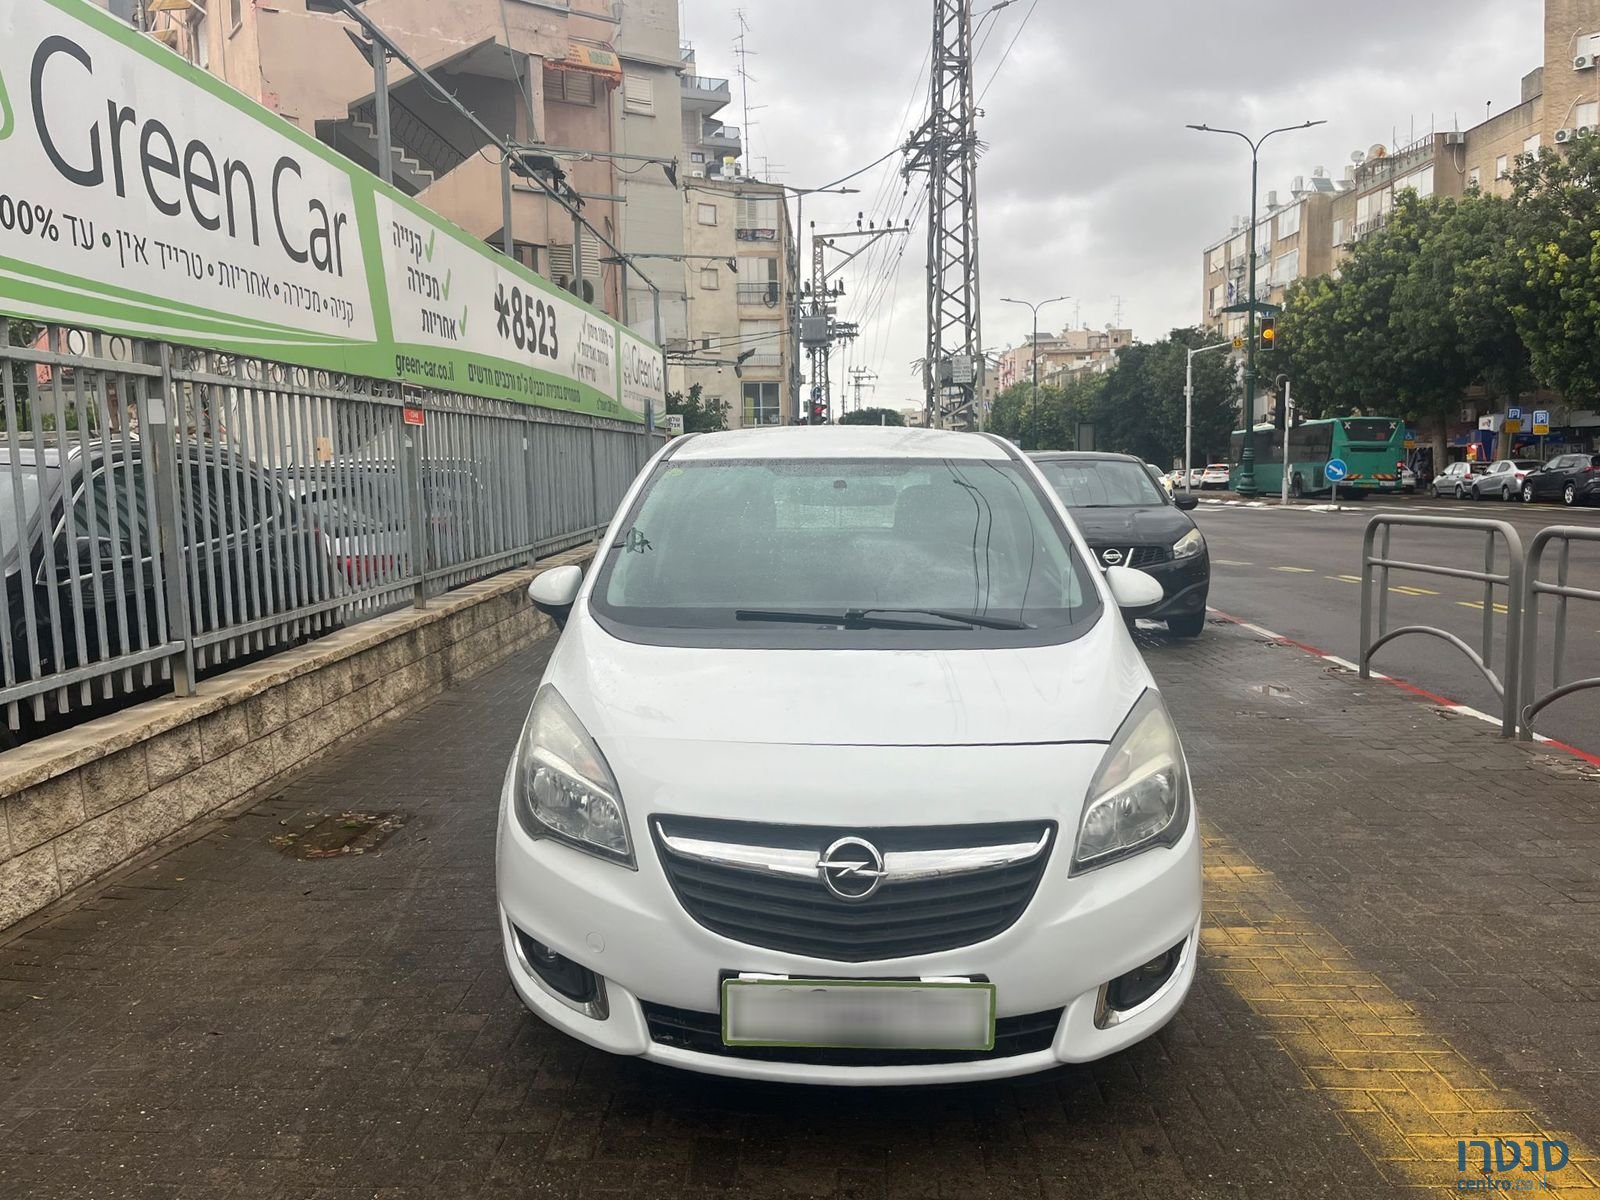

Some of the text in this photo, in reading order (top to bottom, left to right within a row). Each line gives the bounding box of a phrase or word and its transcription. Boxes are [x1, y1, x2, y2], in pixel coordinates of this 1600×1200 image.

[30, 34, 347, 277] Green Car
[63, 214, 94, 250] עד
[116, 229, 149, 268] אין
[392, 220, 422, 265] קנייה
[153, 240, 203, 280] טרייד
[217, 261, 271, 299] אחריות
[283, 281, 321, 313] מכירה
[407, 266, 440, 301] מכירה
[330, 297, 354, 328] קניה
[421, 308, 457, 341] אחריות
[395, 354, 455, 381] green-car.co.il
[468, 362, 494, 384] חדשים
[631, 344, 652, 389] Green
